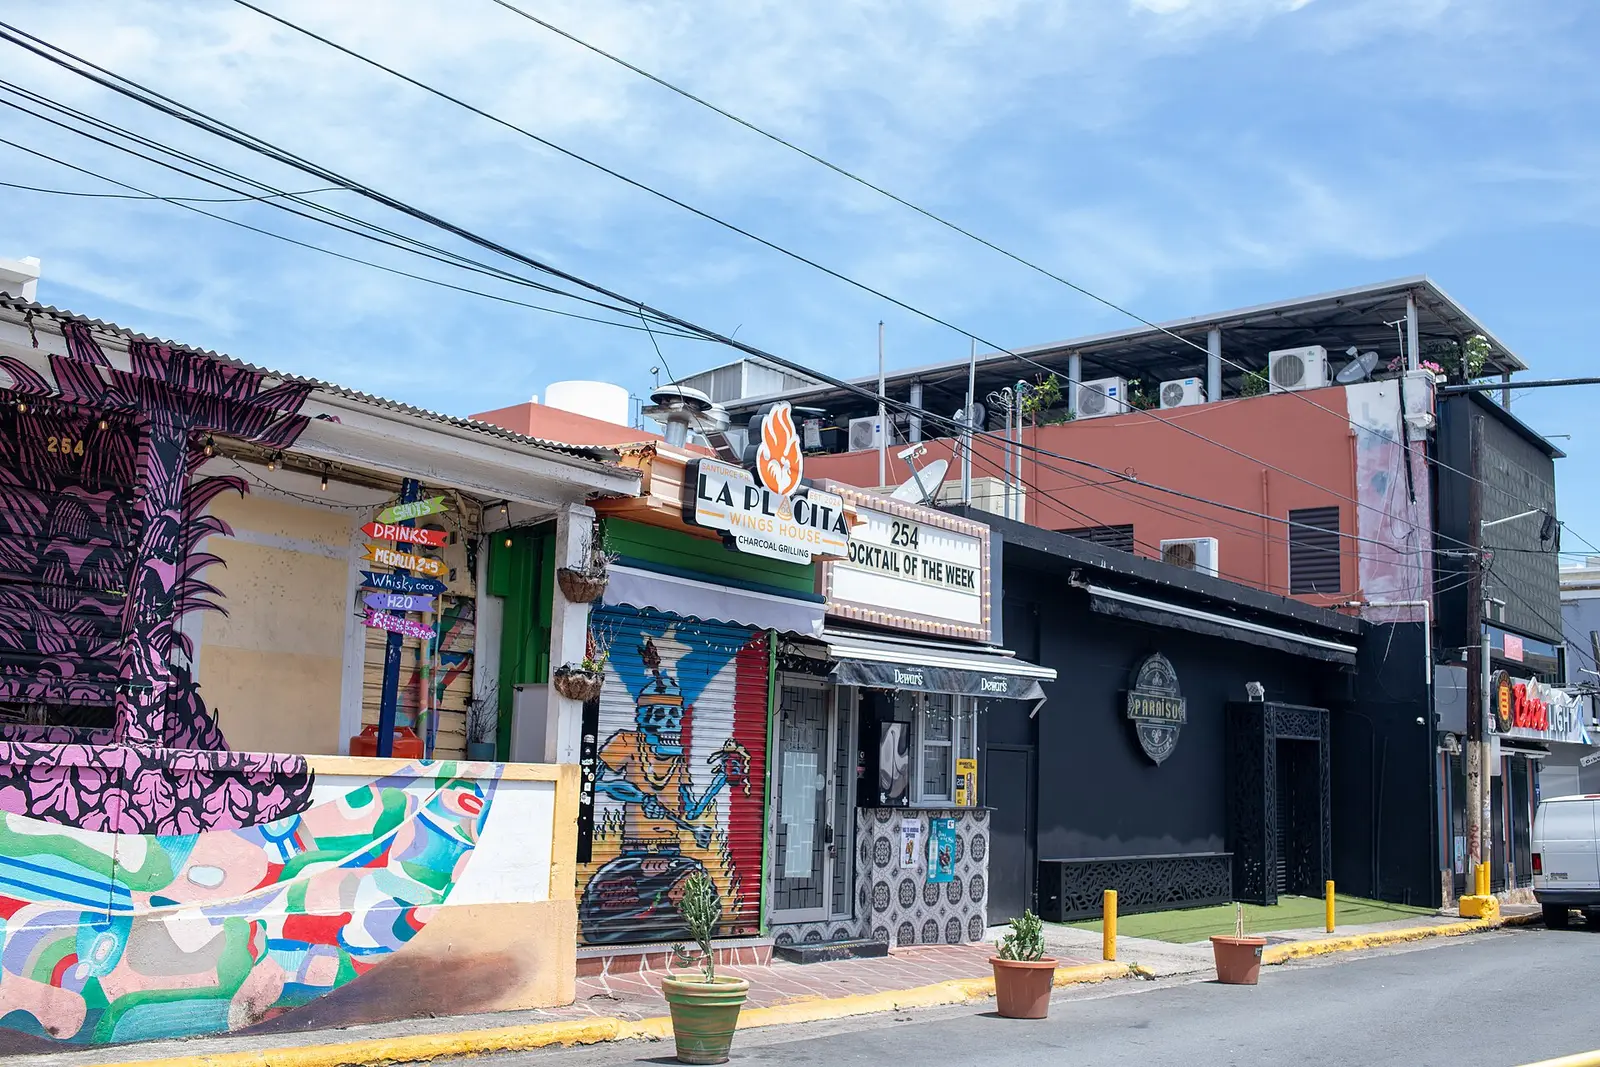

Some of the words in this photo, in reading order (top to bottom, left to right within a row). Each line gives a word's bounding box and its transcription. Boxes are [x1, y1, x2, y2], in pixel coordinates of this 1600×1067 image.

[48, 436, 84, 456] 254
[701, 462, 738, 479] SANTURCE
[698, 473, 734, 507] LA
[393, 500, 431, 521] SHOTS
[729, 511, 774, 533] WINGS
[779, 523, 821, 545] HOUSE
[891, 521, 919, 549] 254
[738, 535, 777, 552] CHARCOAL
[778, 545, 809, 558] GRILLING
[375, 548, 415, 570] MEDALLA
[849, 541, 900, 573] OCKTAIL
[903, 554, 918, 576] OF
[921, 559, 943, 582] THE
[945, 564, 975, 589] WEEK
[372, 573, 413, 592] Whisky
[894, 669, 923, 686] Dewar's
[981, 678, 1007, 692] Dewar's
